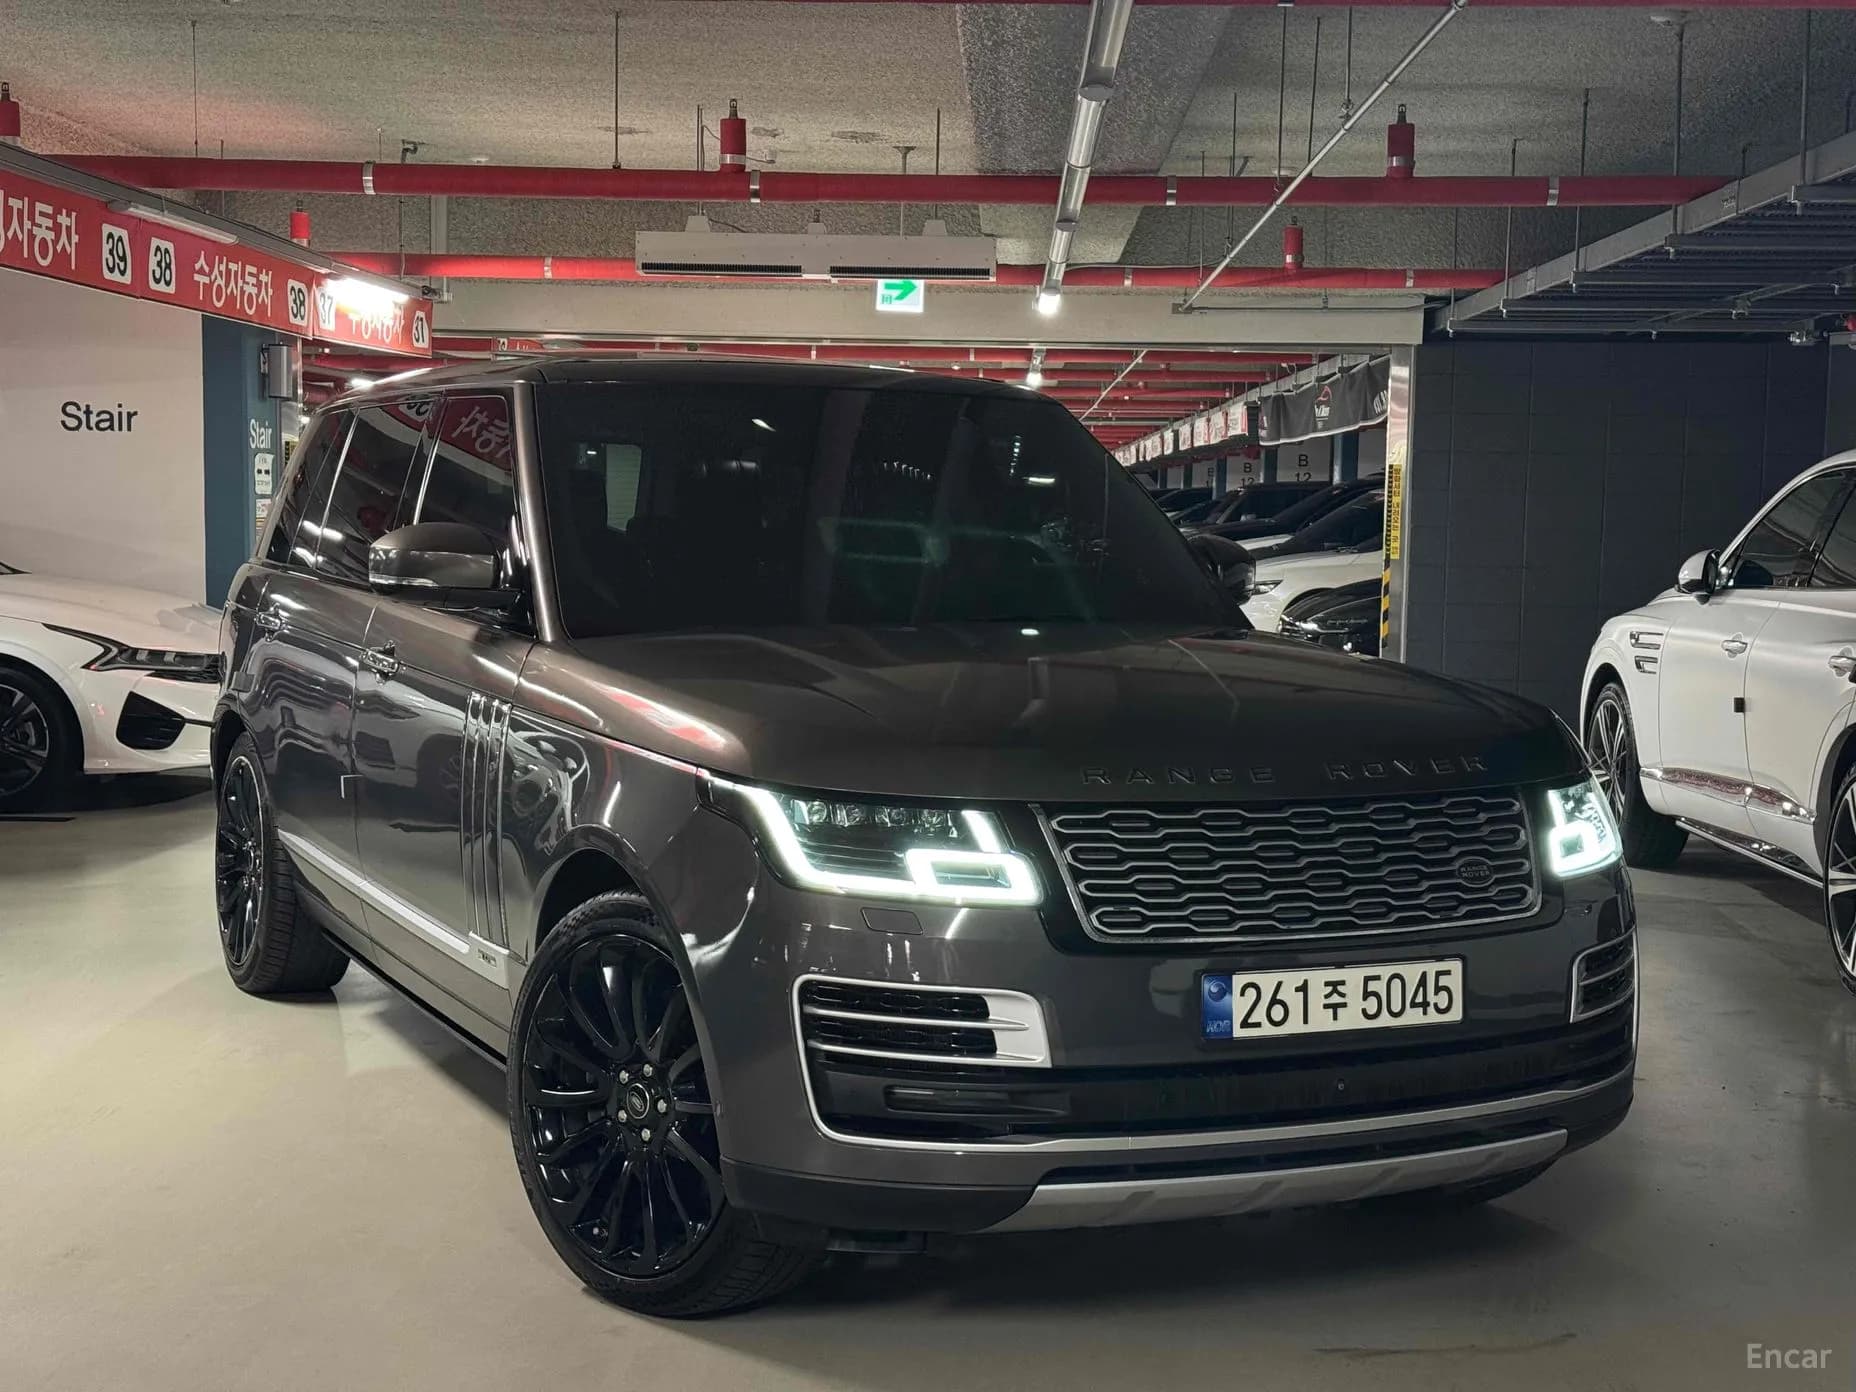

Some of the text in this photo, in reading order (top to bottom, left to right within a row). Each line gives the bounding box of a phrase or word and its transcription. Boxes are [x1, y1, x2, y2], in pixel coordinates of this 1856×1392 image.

[0, 189, 128, 277] 자동차 39
[152, 245, 306, 321] 38 수성자동차 38
[320, 292, 334, 326] 37
[61, 401, 138, 432] Stair
[249, 418, 272, 449] Stair
[1243, 462, 1252, 473] B
[1298, 454, 1309, 467] B
[1295, 472, 1312, 482] 12
[1081, 755, 1488, 784] RANGE ROVER
[1239, 969, 1454, 1029] 261주 5045
